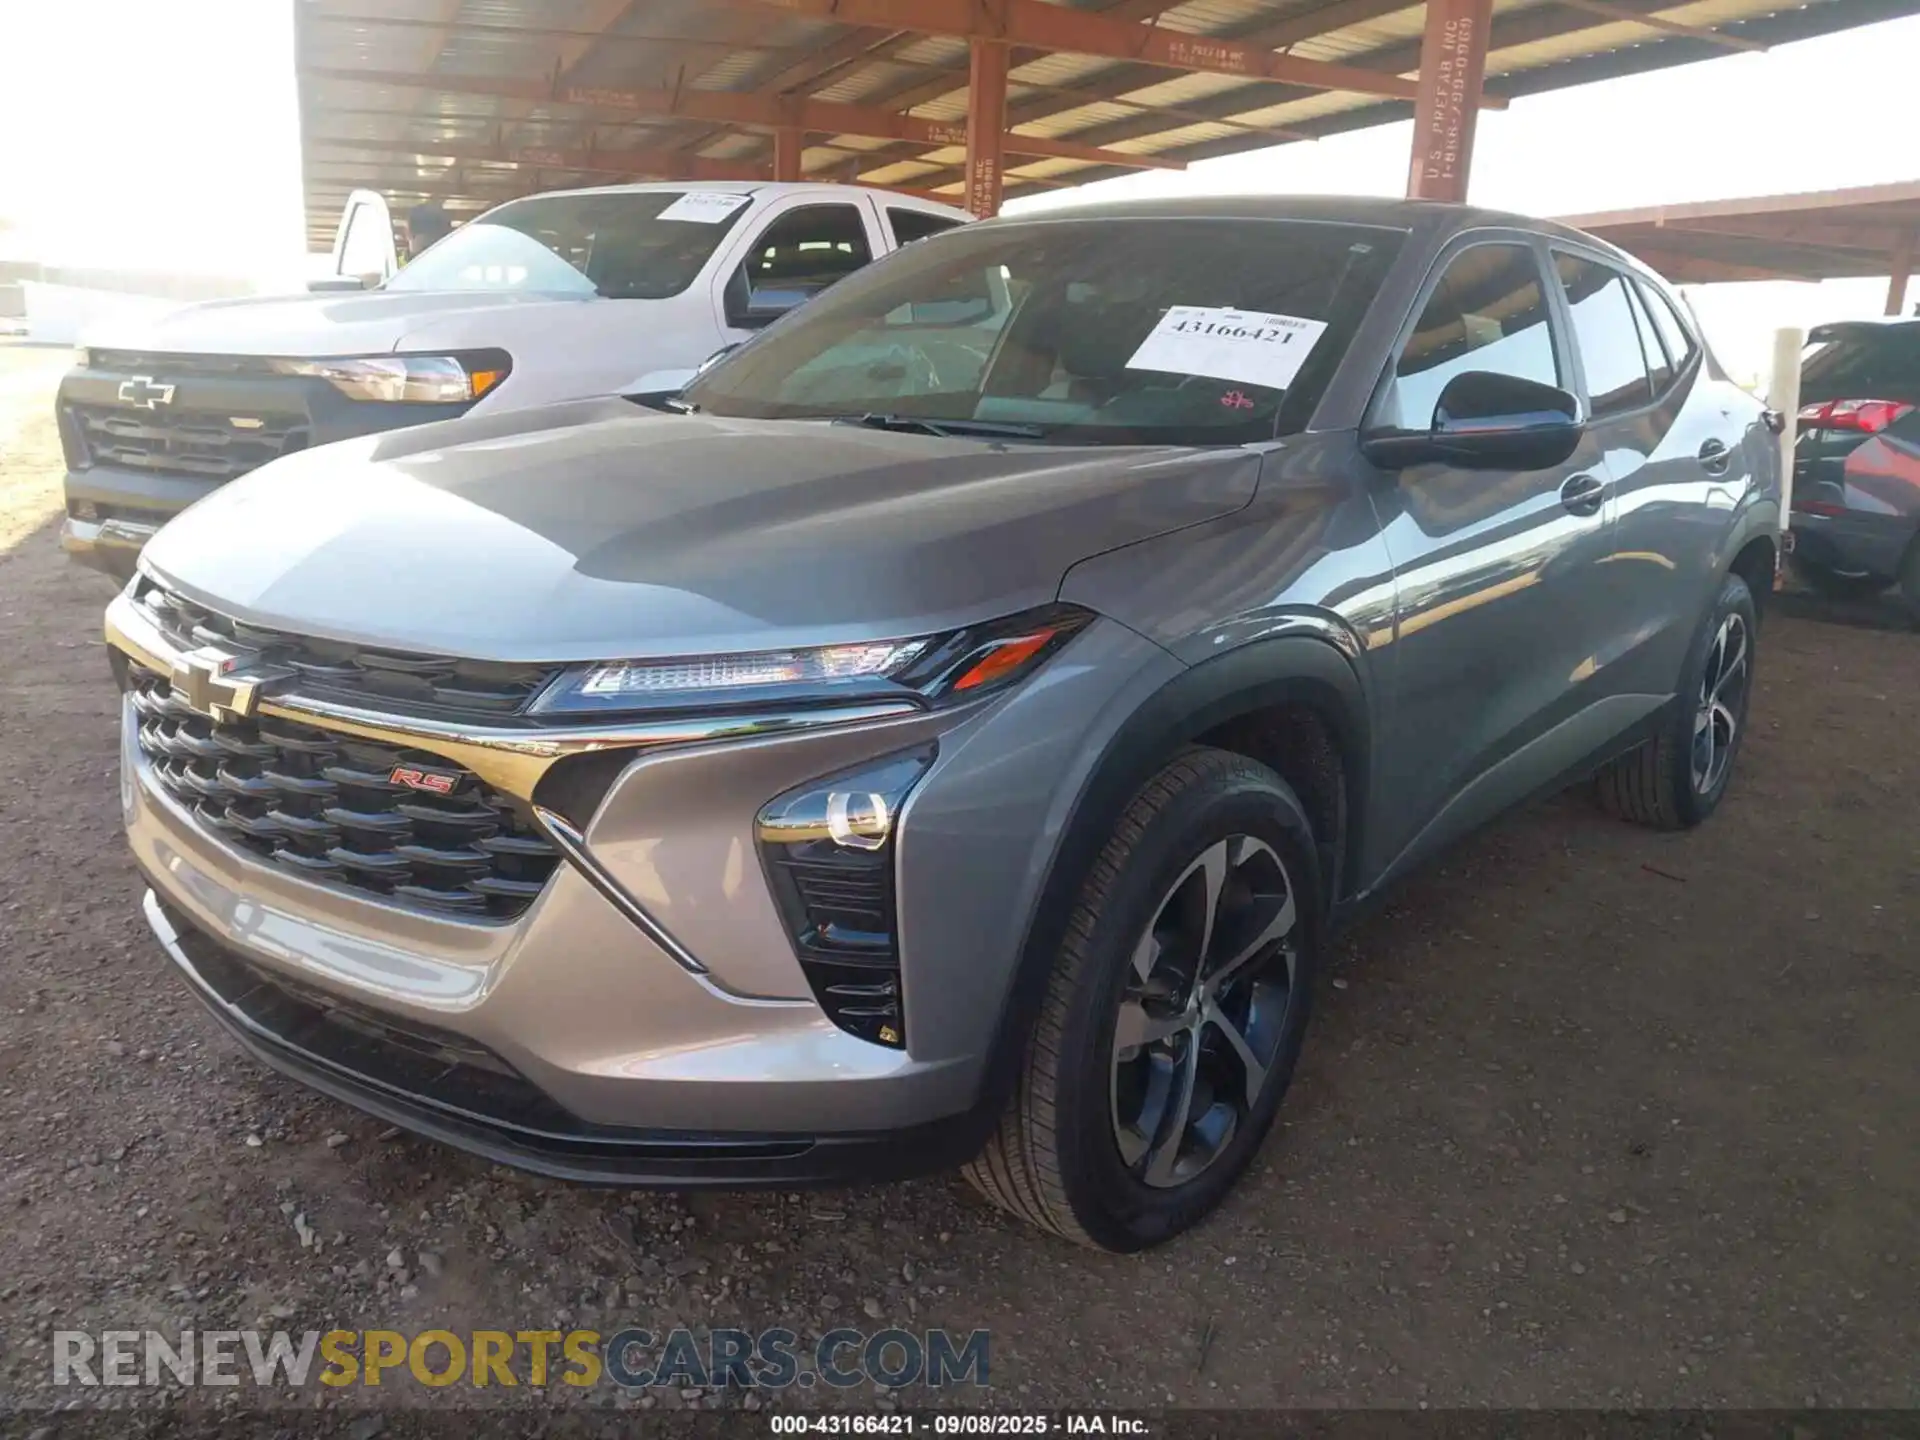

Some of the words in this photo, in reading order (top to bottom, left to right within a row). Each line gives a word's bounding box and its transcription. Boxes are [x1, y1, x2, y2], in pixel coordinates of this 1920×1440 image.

[1440, 19, 1458, 50] INC
[1432, 60, 1453, 134] PREFAB
[1171, 319, 1295, 345] 43166421
[389, 767, 456, 794] RS
